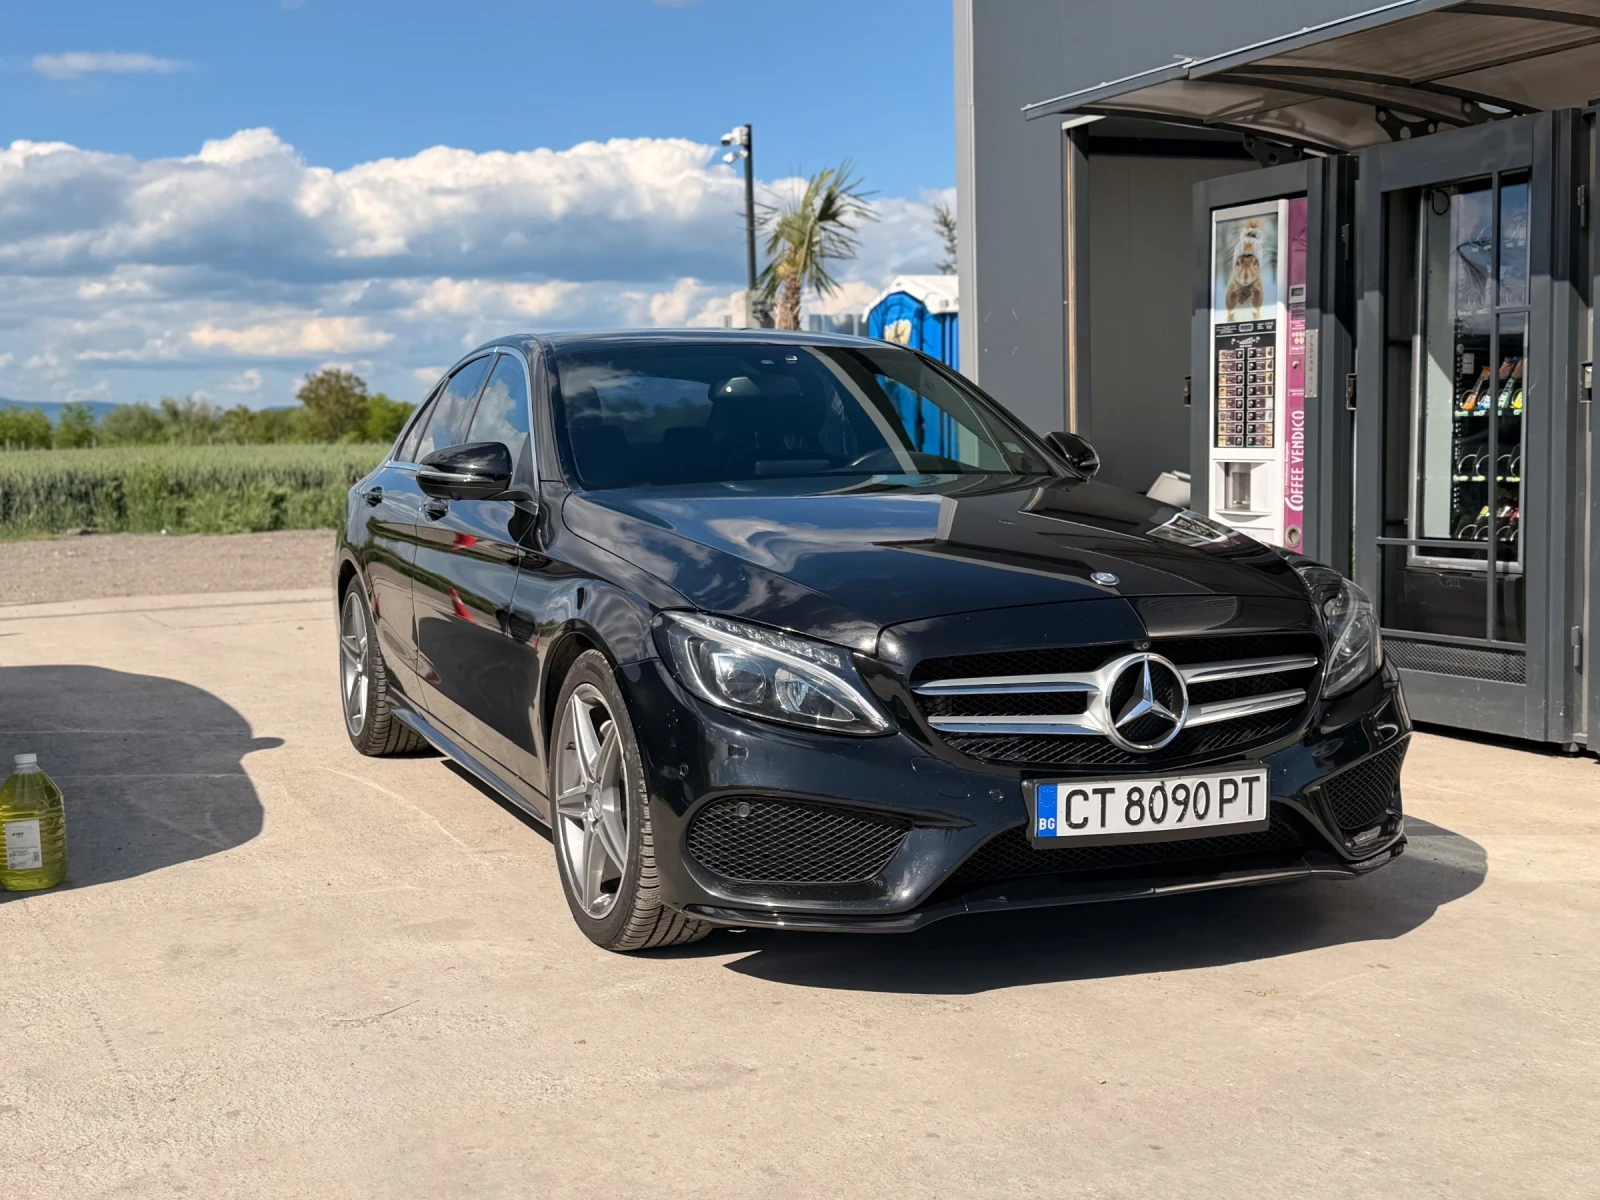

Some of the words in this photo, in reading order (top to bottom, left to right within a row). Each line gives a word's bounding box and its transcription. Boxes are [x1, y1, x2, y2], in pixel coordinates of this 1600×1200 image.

[1291, 410, 1304, 464] VENDICO
[1285, 467, 1304, 512] COFFEE
[1039, 818, 1056, 830] BG
[1065, 787, 1115, 830] CT
[1124, 780, 1211, 826] 8090
[1219, 776, 1261, 819] PT
